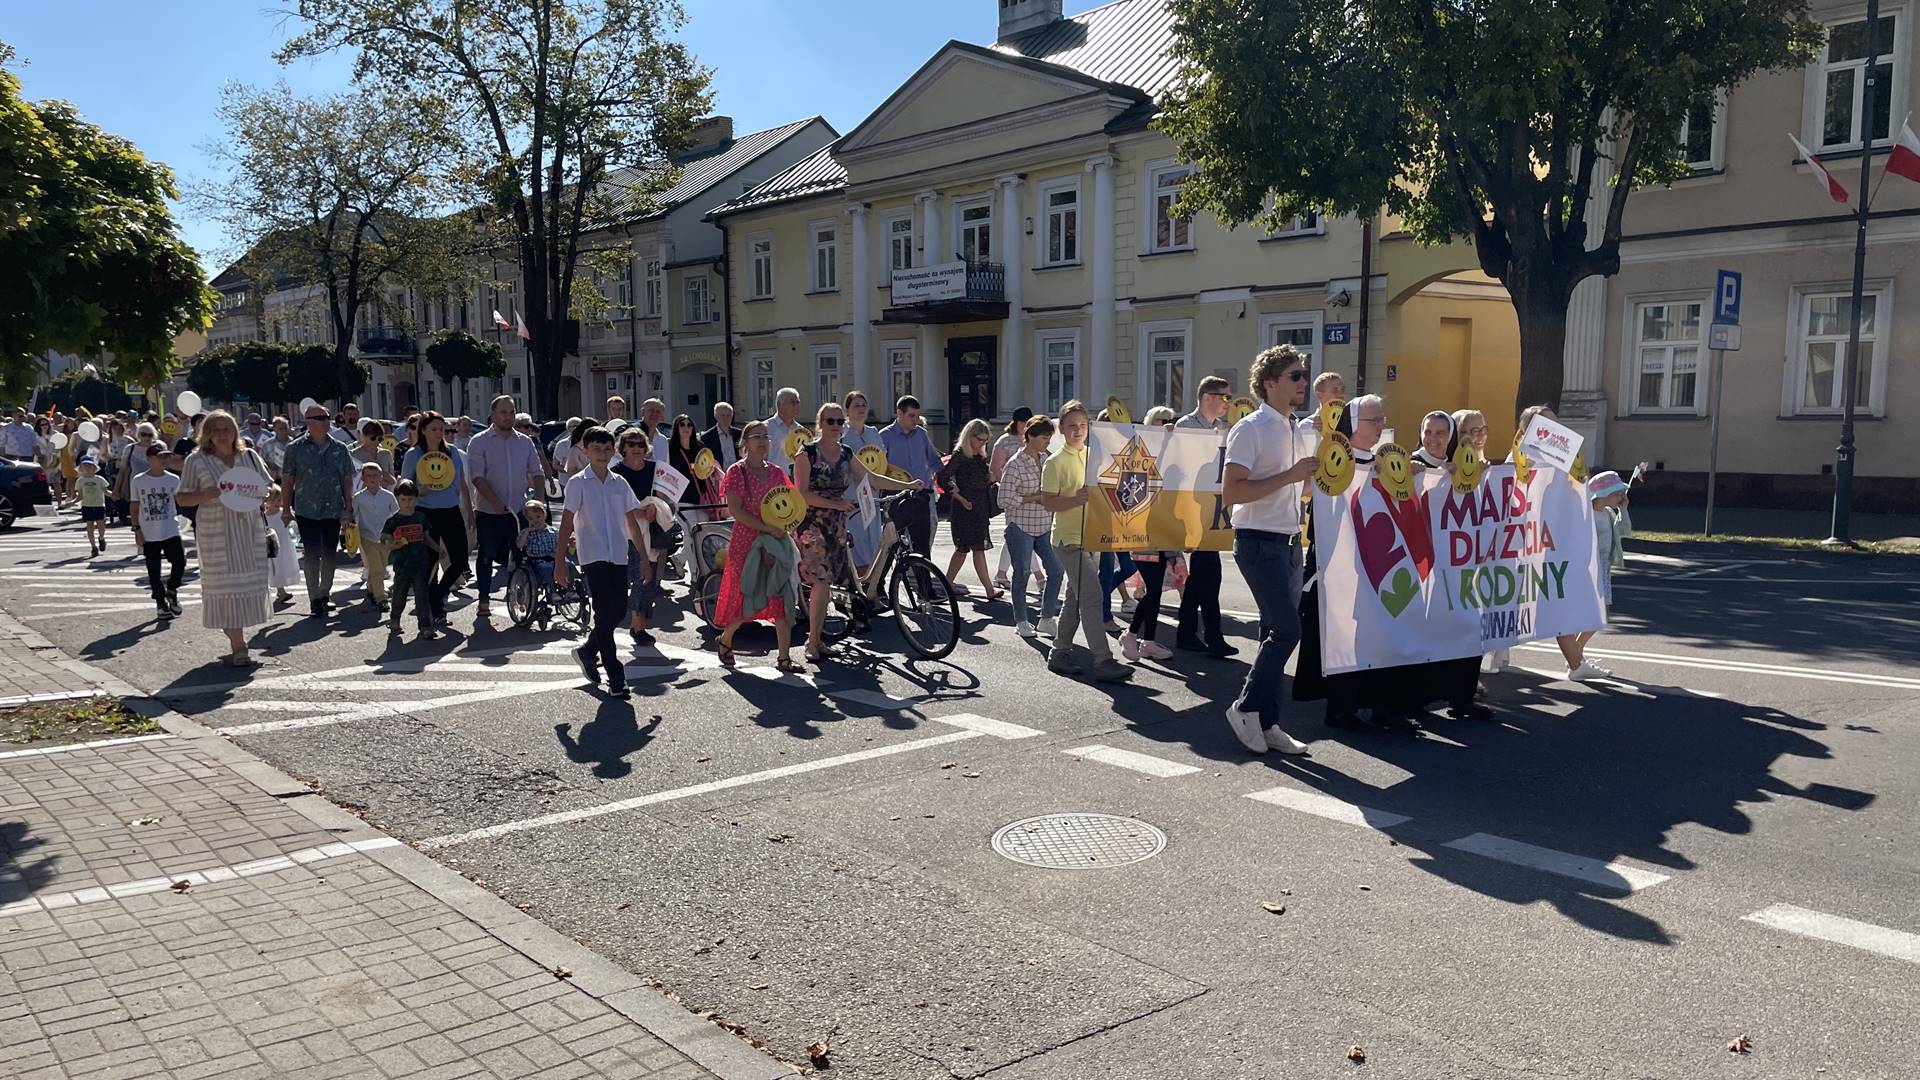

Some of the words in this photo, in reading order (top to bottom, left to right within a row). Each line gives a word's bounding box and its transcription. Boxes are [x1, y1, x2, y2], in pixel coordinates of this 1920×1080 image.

[1721, 276, 1736, 315] P
[1328, 330, 1344, 342] 45
[1121, 458, 1130, 471] K
[1142, 458, 1150, 471] C
[1100, 534, 1119, 544] Rada
[1122, 533, 1131, 543] Nr
[1450, 528, 1497, 566] DLA
[1500, 518, 1556, 559] ŻYCIA
[1442, 569, 1455, 610] I
[1460, 560, 1570, 610] RODZINY
[1480, 607, 1533, 641] SUWAŁKI
